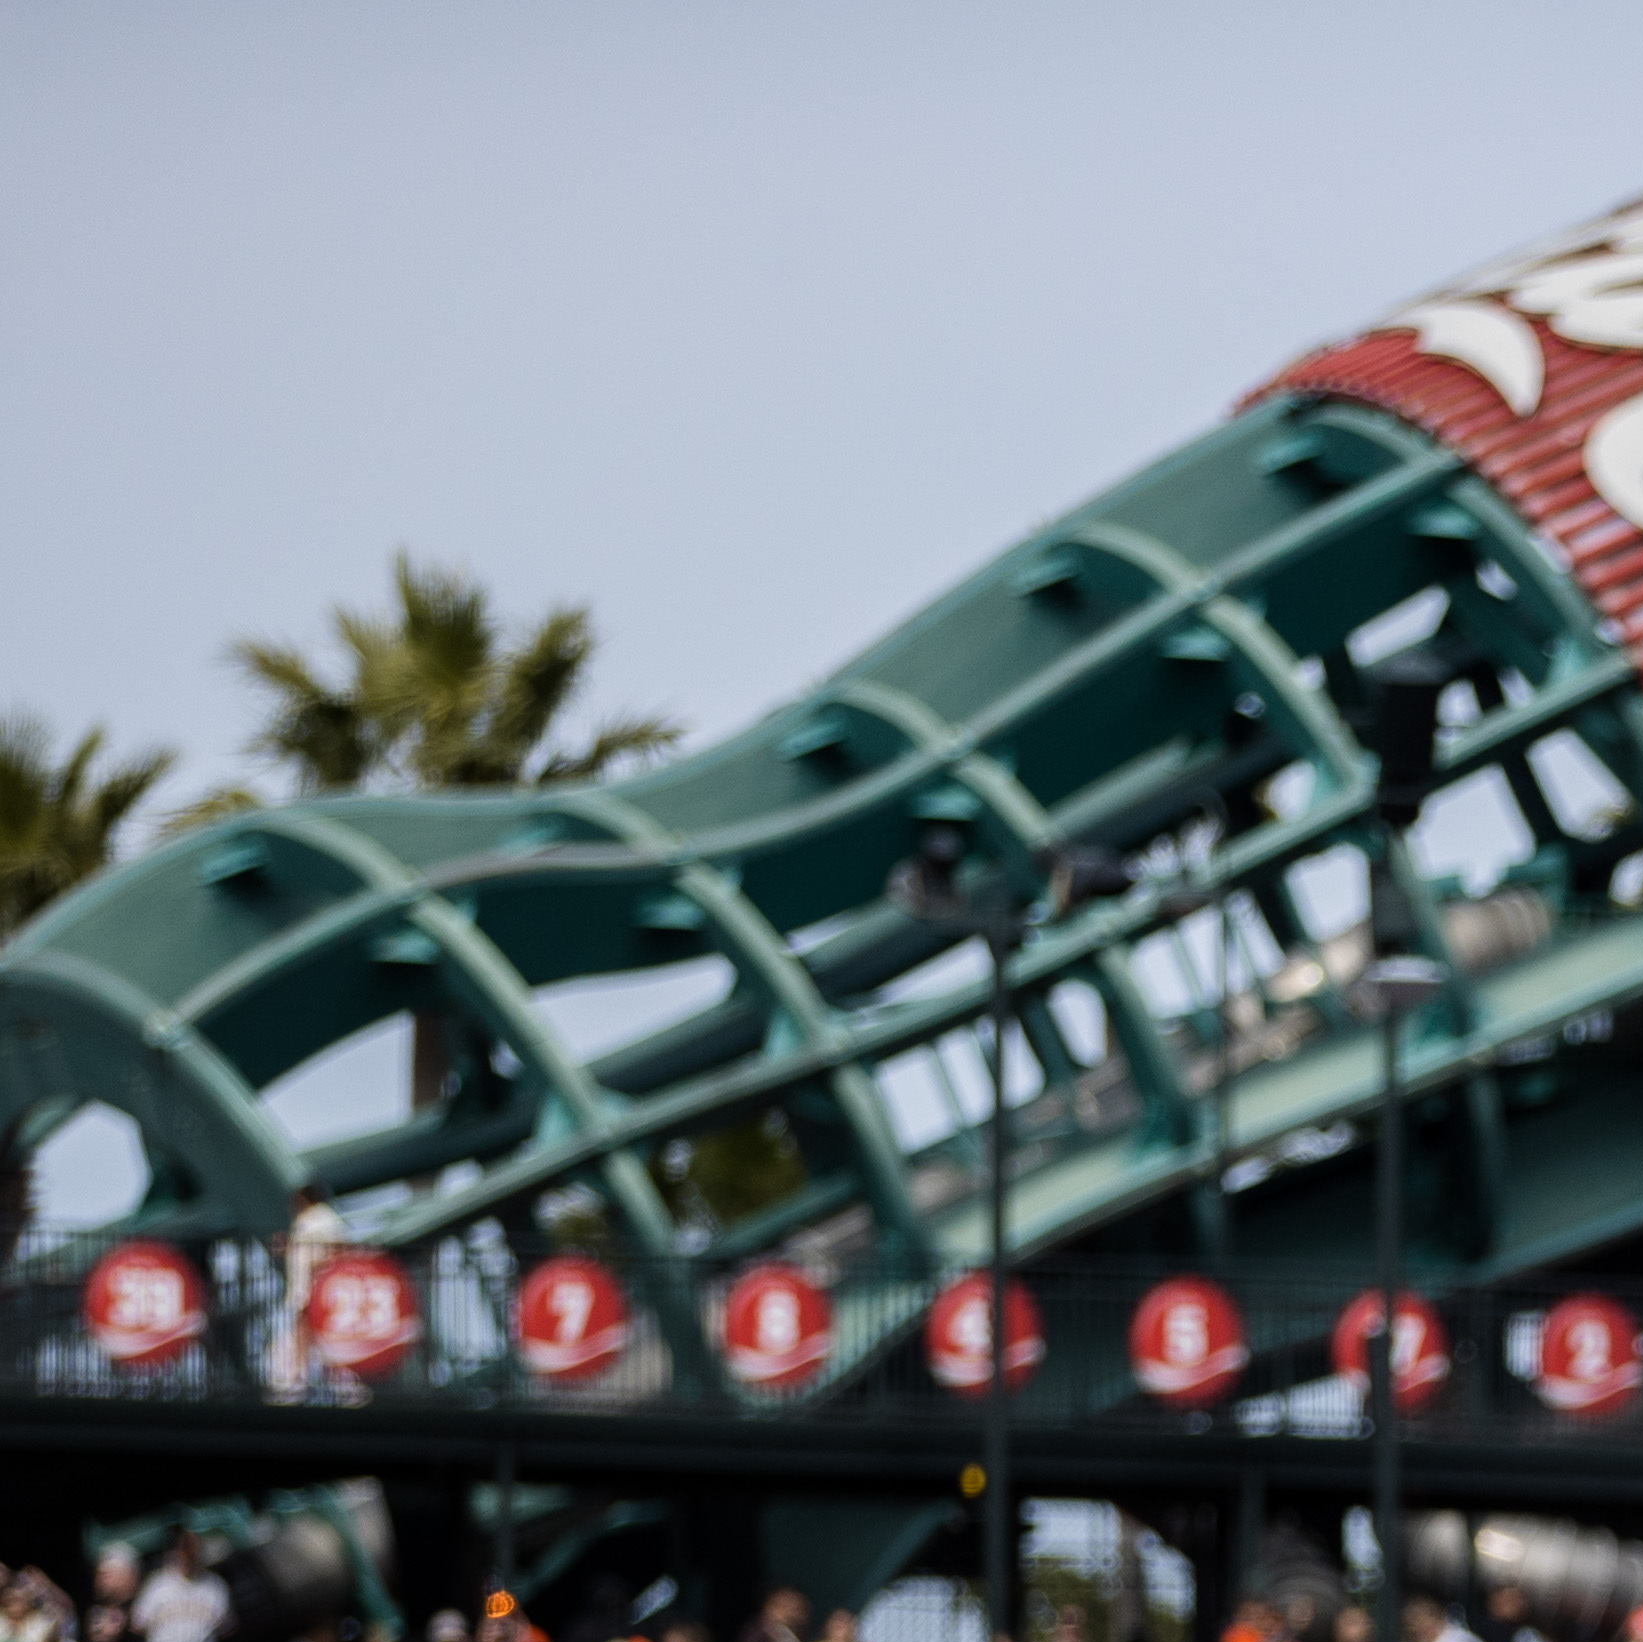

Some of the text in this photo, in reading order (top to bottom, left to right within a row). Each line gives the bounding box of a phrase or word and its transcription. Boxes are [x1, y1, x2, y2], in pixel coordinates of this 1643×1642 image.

[548, 1280, 594, 1346] 7
[948, 1299, 994, 1357] 4
[1566, 1317, 1611, 1380] 2
